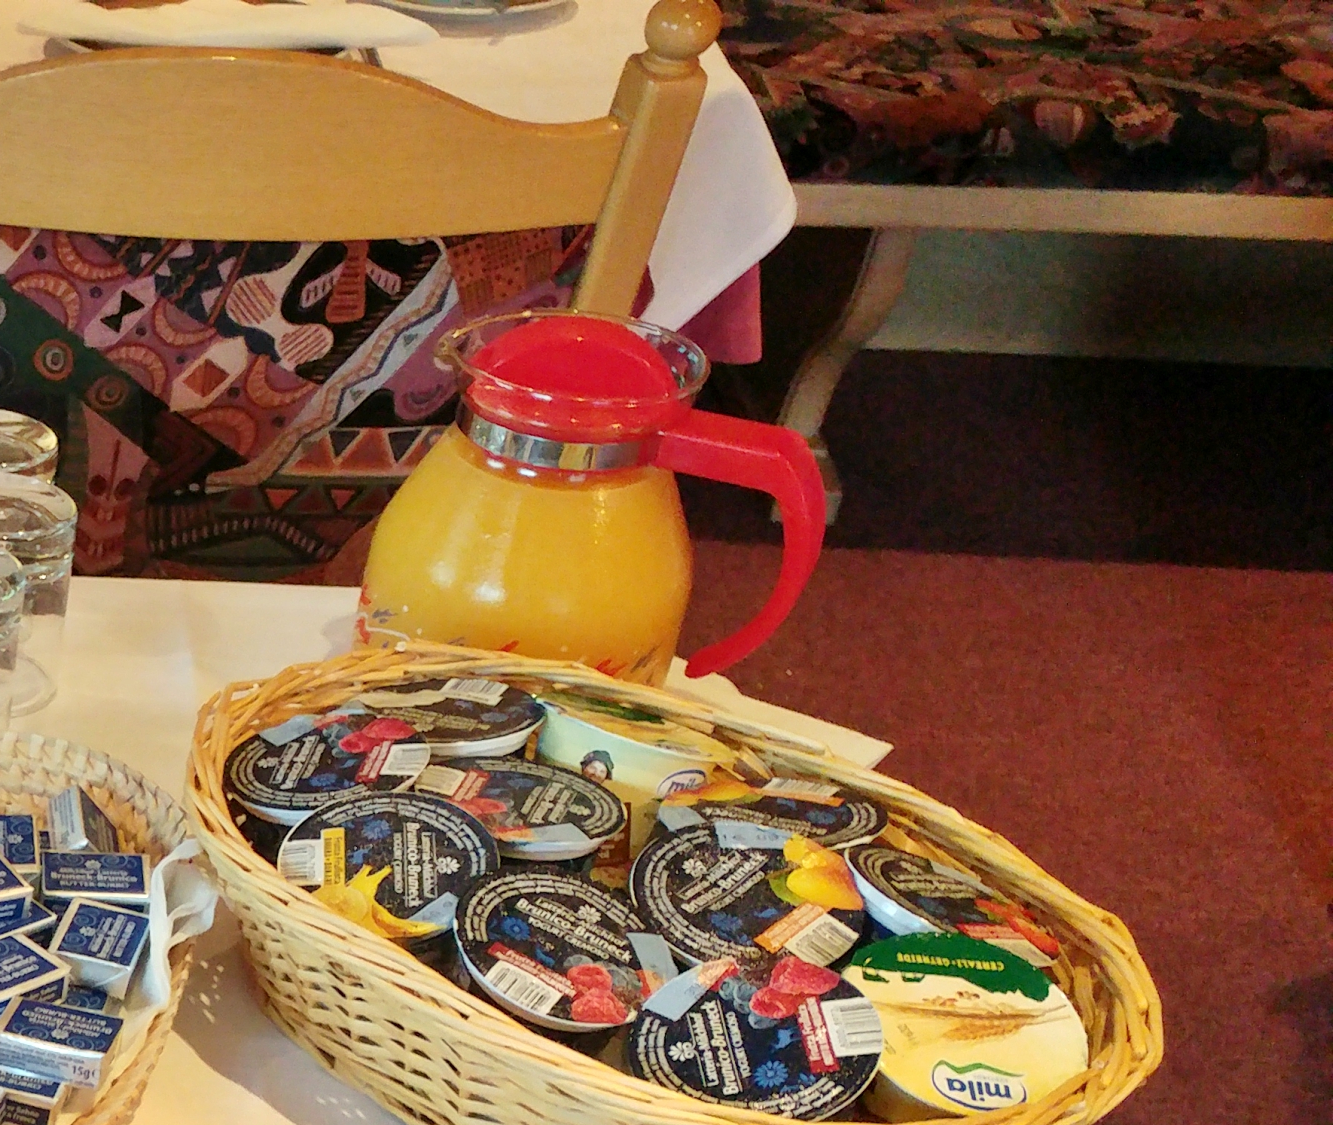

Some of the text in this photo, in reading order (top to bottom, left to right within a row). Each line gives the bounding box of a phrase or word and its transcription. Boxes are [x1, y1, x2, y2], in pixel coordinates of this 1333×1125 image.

[51, 871, 138, 883] Bruneck-Brunico
[681, 851, 768, 914] Brunico-Bruneck
[515, 898, 632, 963] Brunico-Bruneck
[528, 917, 610, 960] YOGURT CREMOSO
[535, 898, 627, 947] Latteria-Milchhof
[700, 1000, 740, 1096] Brunico-Bruneck
[71, 1064, 90, 1080] 15g
[946, 1077, 1014, 1102] mila
